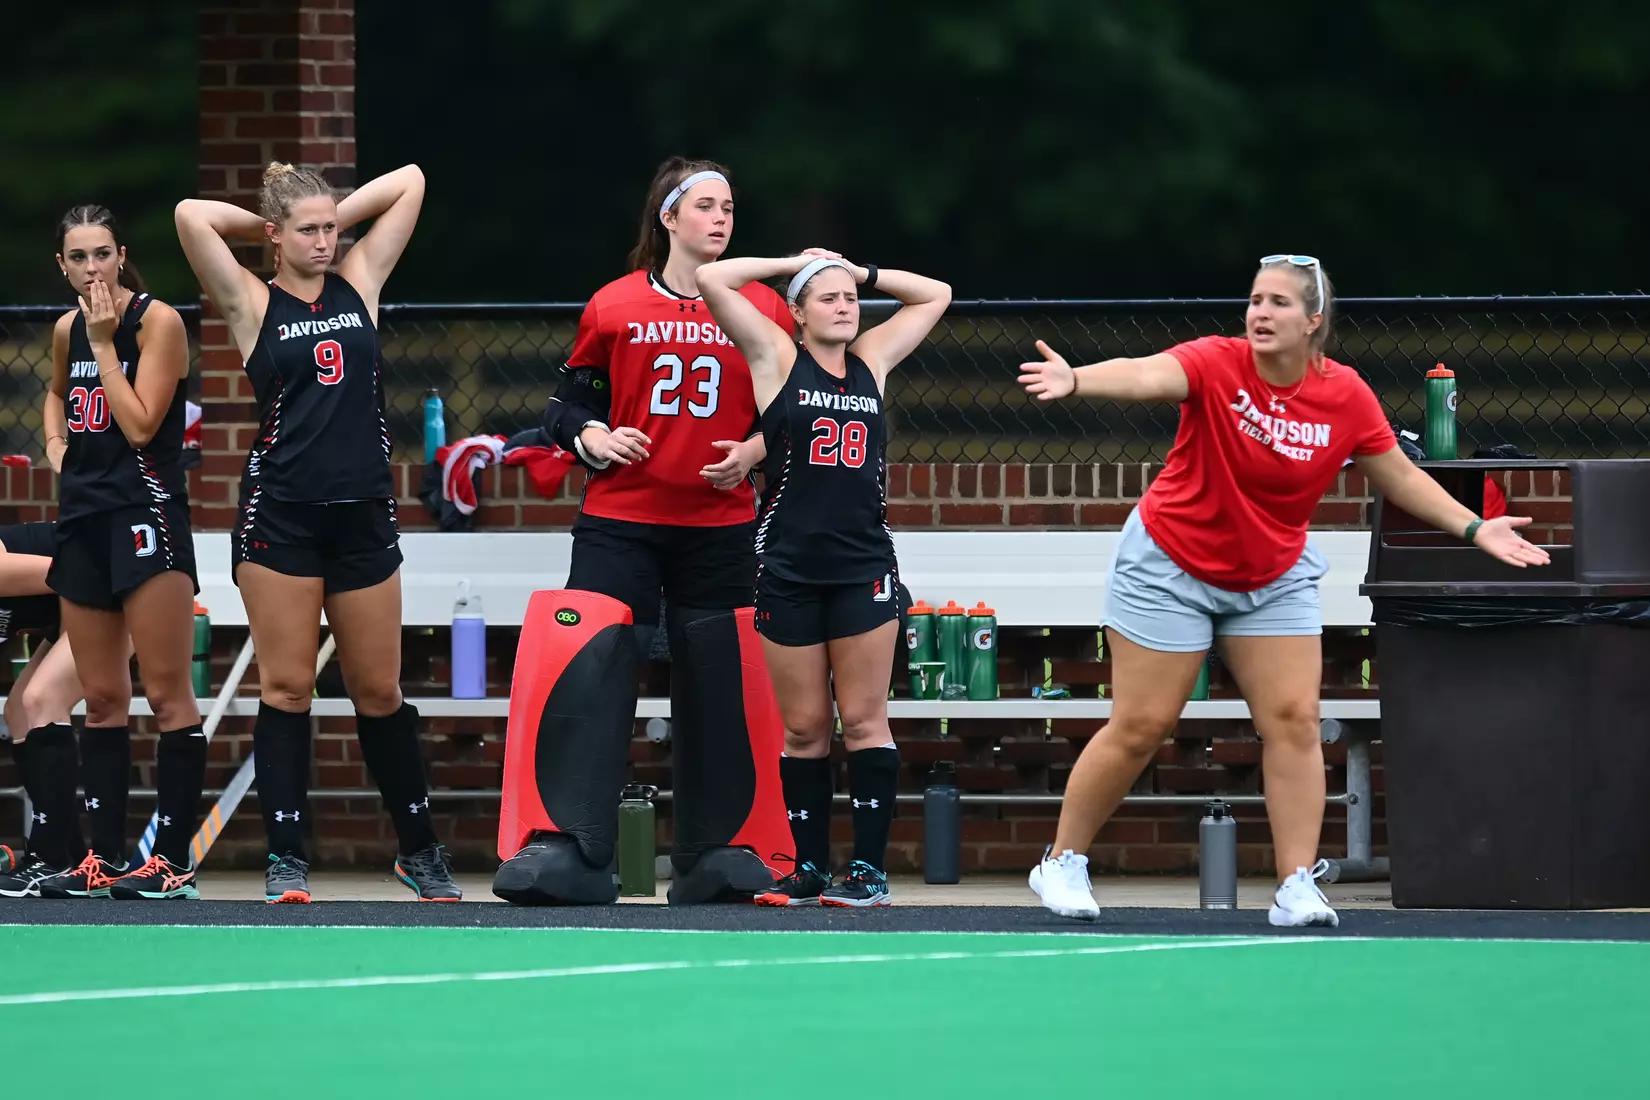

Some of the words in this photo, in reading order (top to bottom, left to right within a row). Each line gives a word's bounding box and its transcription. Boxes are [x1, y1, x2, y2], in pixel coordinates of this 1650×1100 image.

[277, 312, 363, 341] DAVIDSON
[628, 321, 735, 347] DAVIDSO
[313, 339, 344, 385] 9
[648, 353, 721, 418] 23
[68, 386, 111, 432] 30
[797, 389, 878, 415] DAVIDSON
[808, 417, 867, 468] 28
[1238, 418, 1272, 445] FIELD
[131, 524, 157, 557] D
[557, 611, 577, 623] OBO
[973, 629, 991, 649] G
